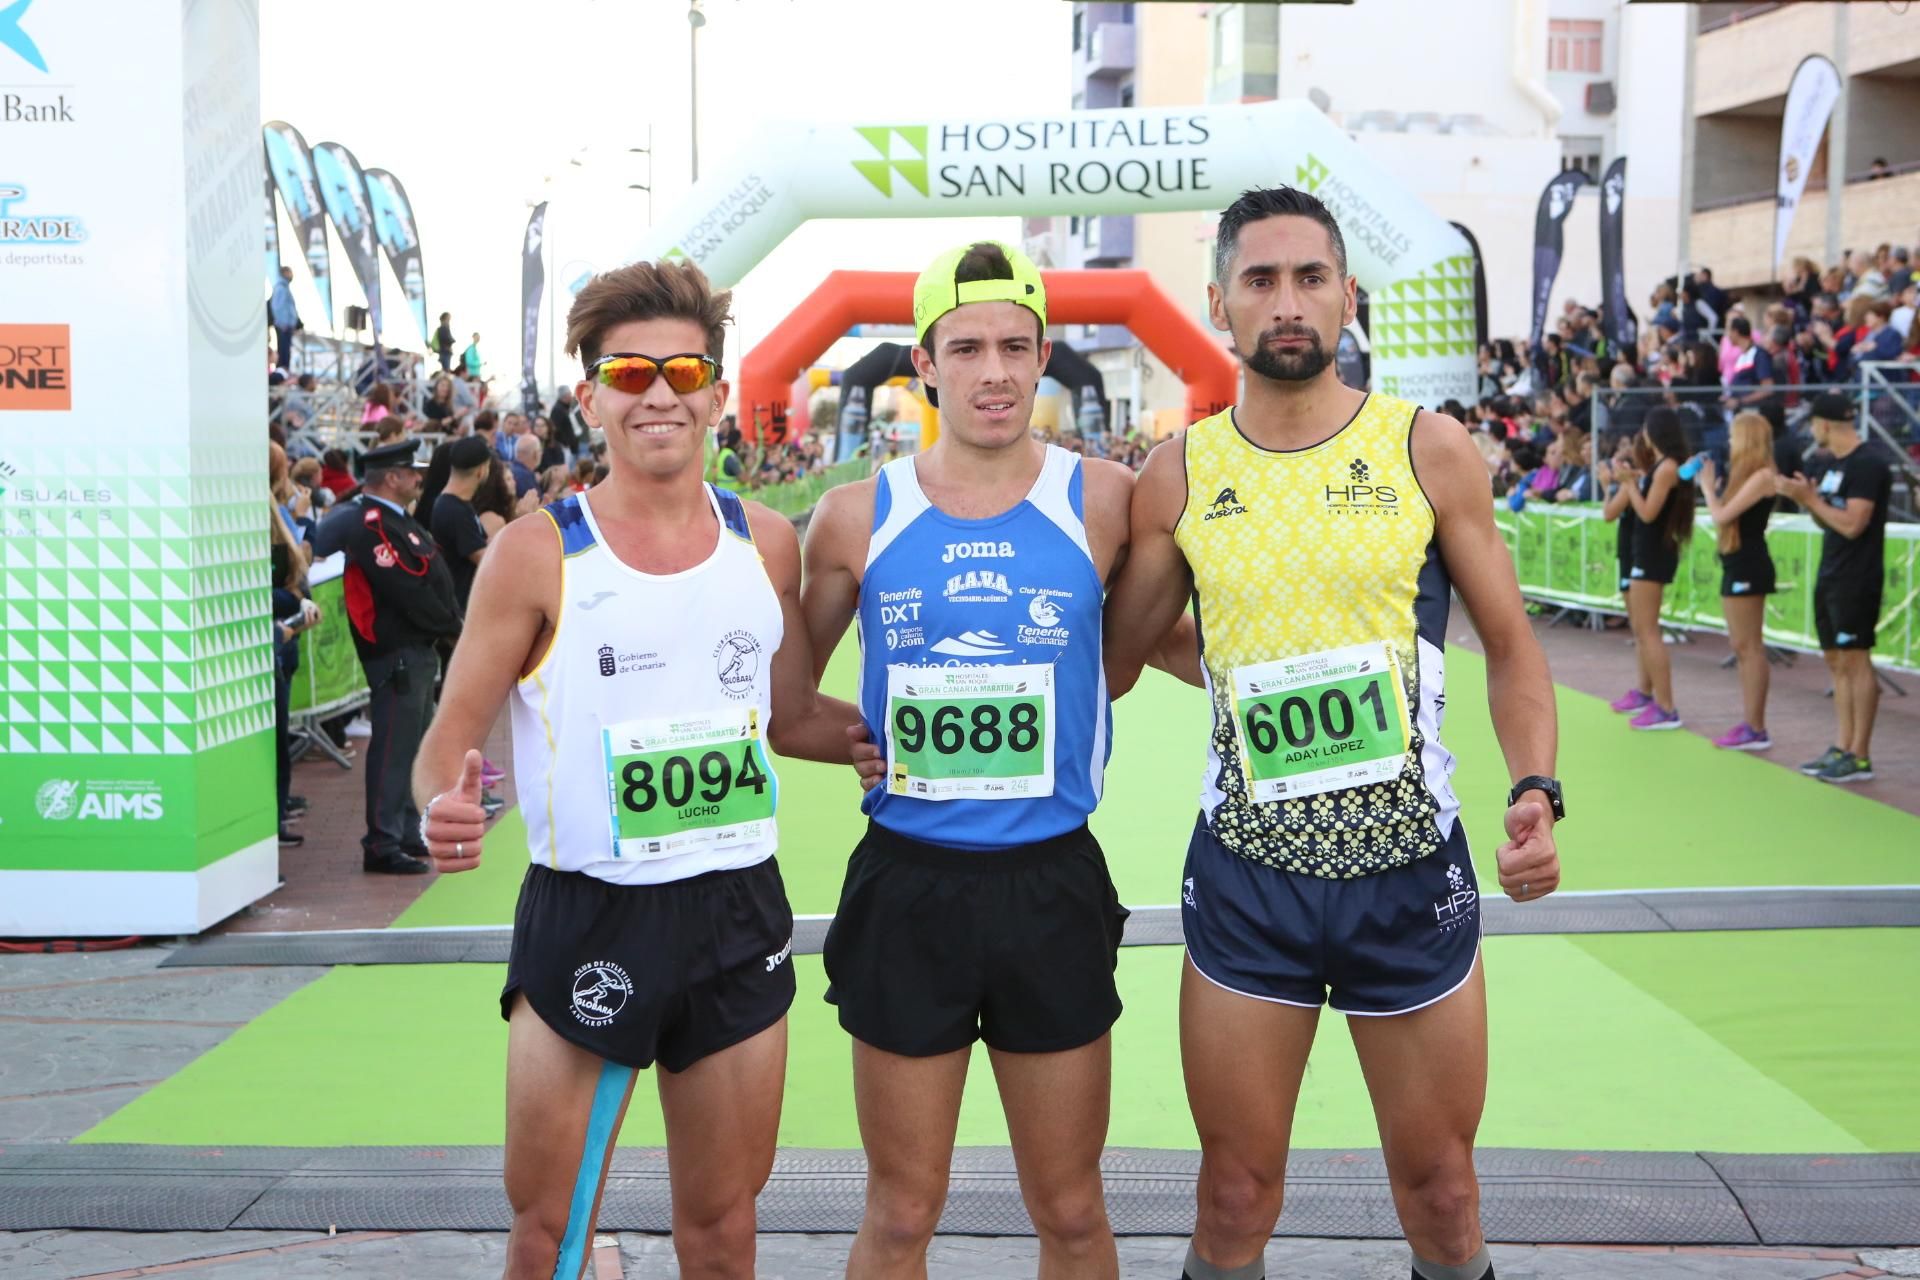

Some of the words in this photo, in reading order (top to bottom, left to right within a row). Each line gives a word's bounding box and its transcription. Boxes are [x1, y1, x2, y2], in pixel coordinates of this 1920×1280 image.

[939, 115, 1211, 152] HOSPITALES
[939, 164, 1026, 198] SAN
[1049, 158, 1212, 199] ROQUE
[680, 173, 762, 252] HOSPITALES
[1326, 175, 1415, 254] HOSPITALES
[691, 235, 723, 264] SAN
[722, 184, 776, 236] ROQUE
[1347, 216, 1401, 266] ROQUE
[5, 250, 84, 267] deportistas
[0, 368, 66, 389] NE
[1326, 485, 1398, 502] HPS
[879, 587, 923, 604] Tenerife
[1019, 586, 1037, 595] Club
[1037, 588, 1073, 598] Atletismo
[880, 602, 922, 625] DXT
[1017, 624, 1069, 639] Tenerife
[1017, 634, 1068, 647] CajaCanarias
[898, 637, 925, 649] .com
[618, 651, 658, 663] Gobierno
[619, 665, 630, 673] de
[631, 661, 666, 672] Canarias
[918, 686, 941, 694] GRAN
[942, 685, 978, 693] CANARIA
[1260, 679, 1283, 690] GRAN
[1284, 672, 1321, 685] CANARIA
[1246, 680, 1388, 754] 6001
[895, 702, 1040, 755] 9688
[1285, 749, 1319, 764] ADAY
[1323, 739, 1365, 757] LÓPEZ
[622, 745, 767, 812] 8094
[77, 792, 163, 820] AIMS
[678, 805, 720, 820] LUCHO
[574, 962, 592, 977] CLUB
[593, 960, 605, 968] DE
[605, 961, 634, 995] ATLETISMO
[569, 1004, 614, 1027] LANZAROTE
[576, 997, 613, 1015] GLOBARA
